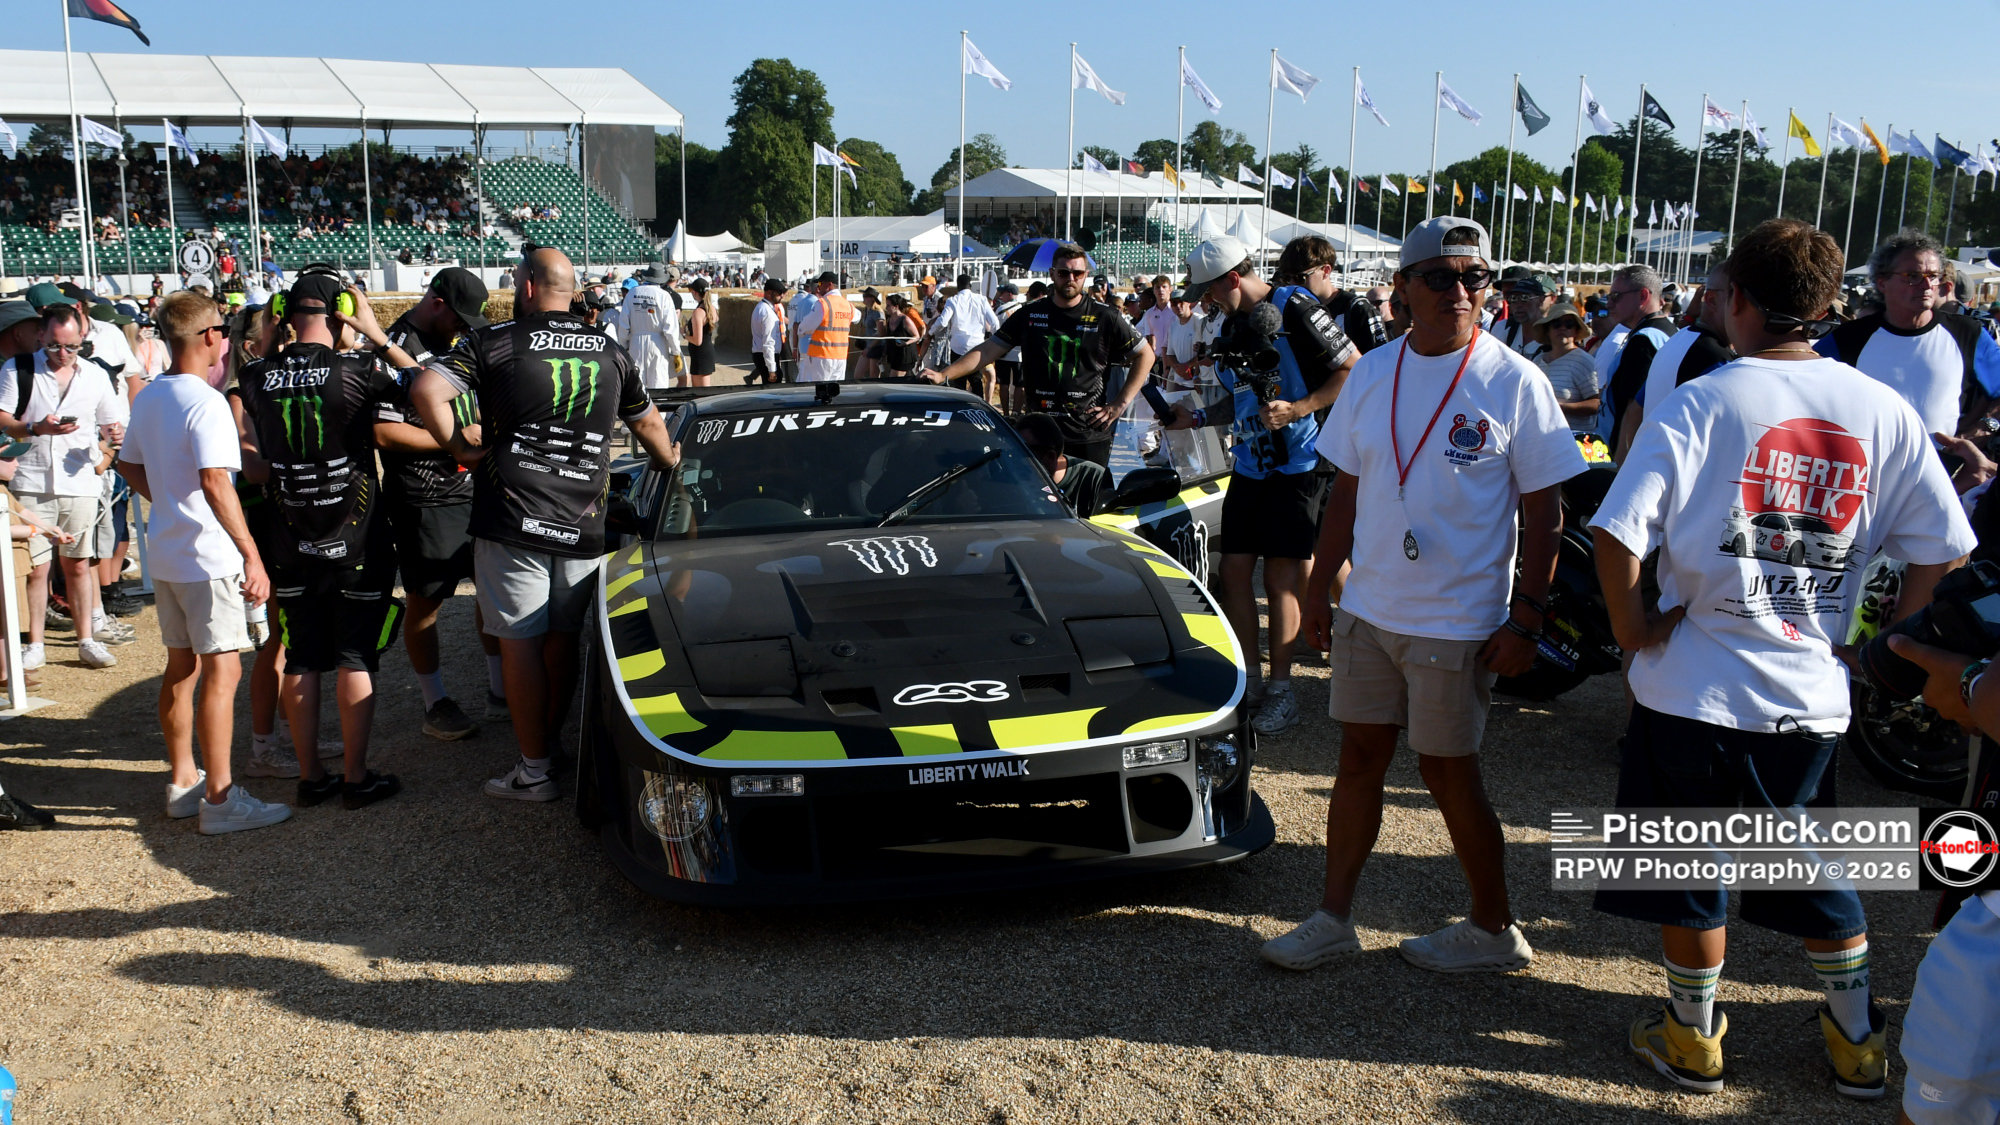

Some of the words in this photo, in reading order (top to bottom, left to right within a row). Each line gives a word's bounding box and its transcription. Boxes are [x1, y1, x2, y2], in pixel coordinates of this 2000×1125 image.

[191, 249, 201, 266] 4
[839, 243, 859, 255] BAR
[731, 409, 953, 438] リバティーウォーク
[1745, 446, 1869, 492] LIBERTY
[1763, 478, 1846, 518] WALK
[537, 526, 579, 541] STAUFF
[1756, 532, 1768, 546] 23
[908, 764, 978, 785] LIBERTY
[981, 759, 1030, 779] WALK
